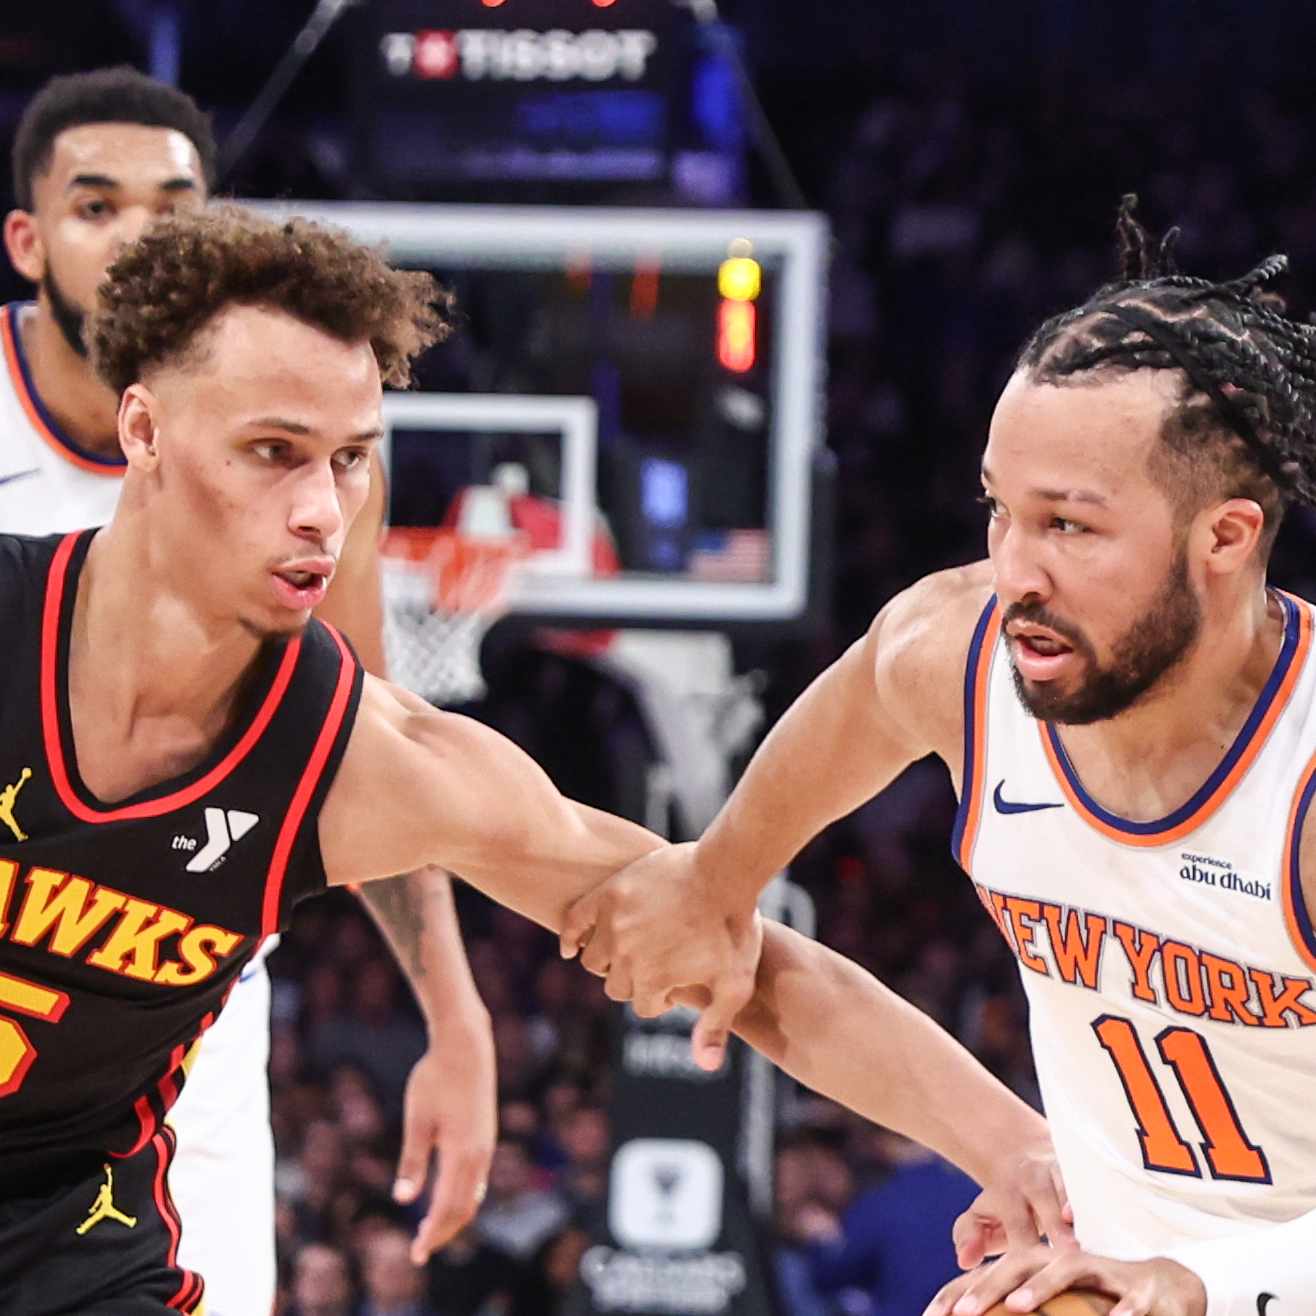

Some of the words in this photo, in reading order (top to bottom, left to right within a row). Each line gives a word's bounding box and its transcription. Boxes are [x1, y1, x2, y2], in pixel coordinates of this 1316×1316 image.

[456, 28, 657, 81] TISSOT
[171, 835, 197, 851] the
[1181, 853, 1233, 870] experience
[1179, 864, 1216, 886] abu
[1219, 872, 1272, 901] dhabi
[977, 884, 1108, 992] NEW
[1091, 1013, 1273, 1186] 11
